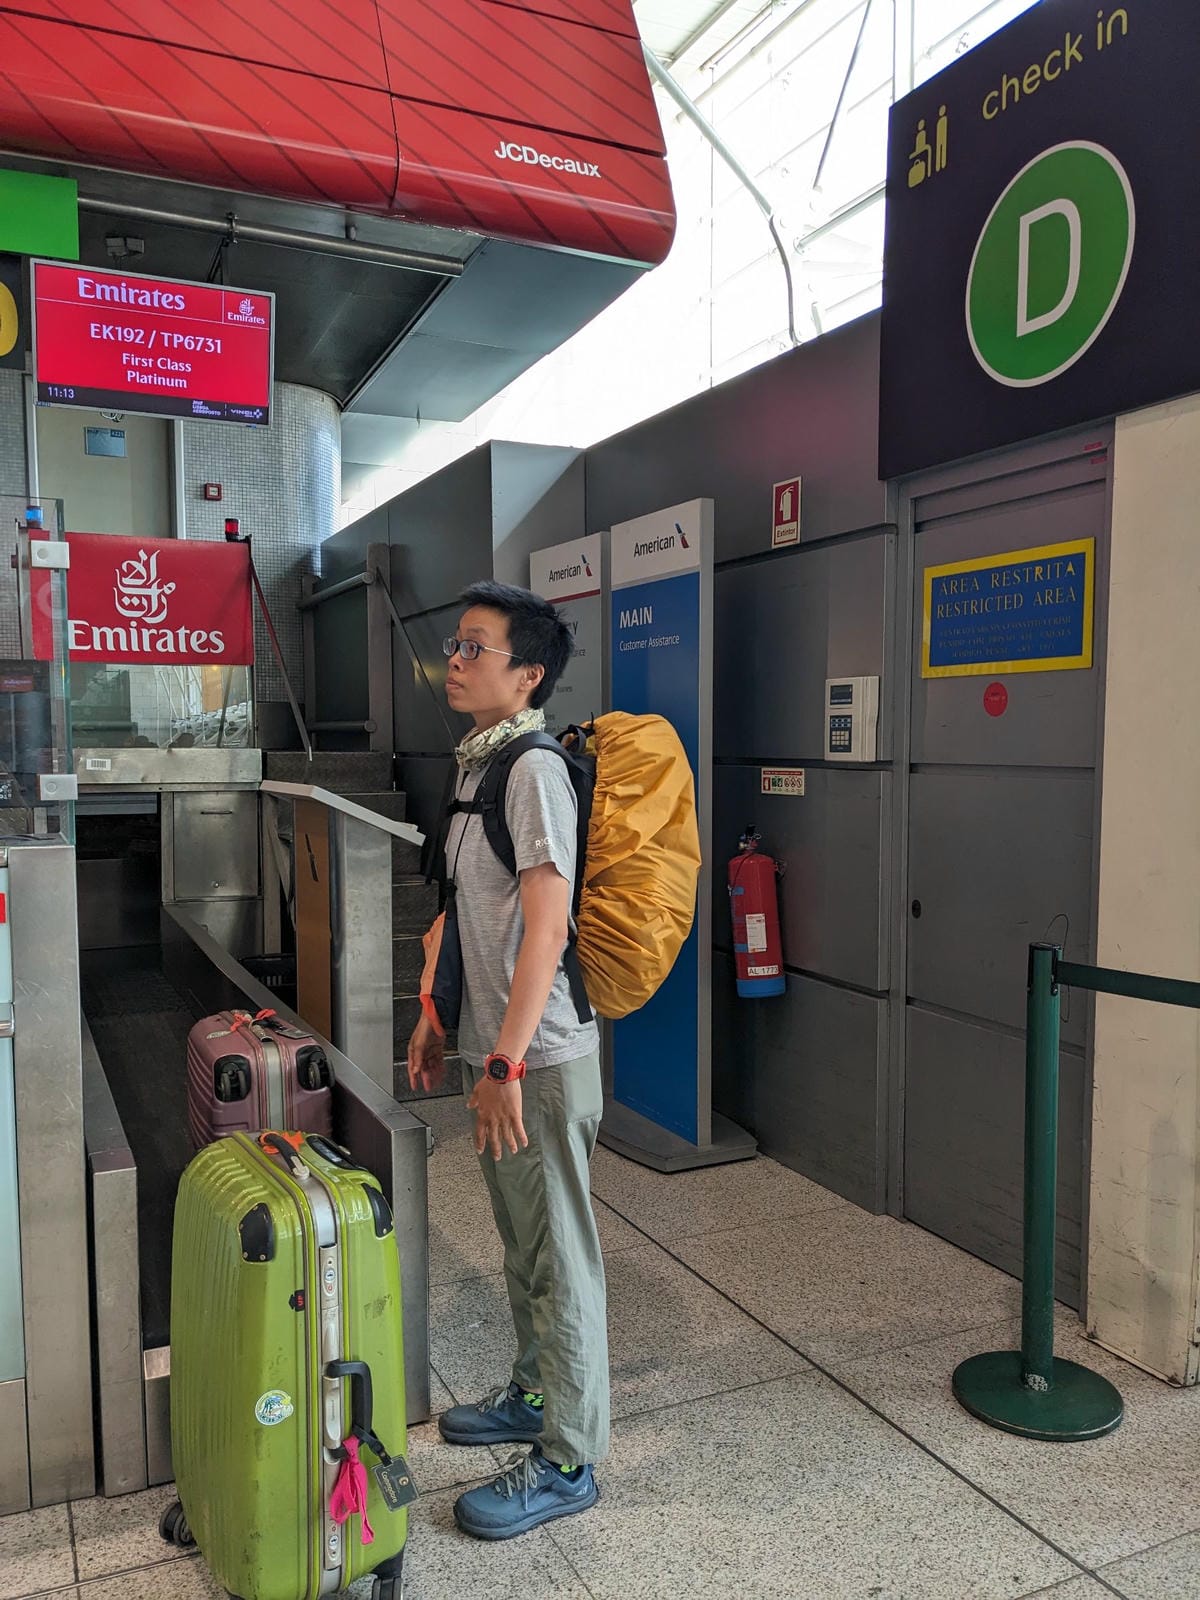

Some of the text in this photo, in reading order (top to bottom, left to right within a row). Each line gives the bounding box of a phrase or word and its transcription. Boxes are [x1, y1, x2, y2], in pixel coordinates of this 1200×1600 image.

[982, 8, 1127, 119] check in
[494, 141, 602, 178] JCDecaux
[1016, 198, 1081, 338] D
[77, 277, 186, 311] Emirates
[227, 312, 266, 325] Emirates
[90, 323, 222, 354] EK192 / TP6731
[122, 353, 192, 373] First Class
[127, 370, 188, 389] Platinum
[48, 387, 74, 399] 11:13
[777, 528, 795, 538] Extintor
[634, 535, 675, 557] American
[549, 564, 582, 583] American
[991, 561, 1076, 588] RESTRITA
[937, 586, 1076, 619] RESTRICTED AREA
[619, 606, 653, 629] MAIN
[68, 619, 225, 654] Emirates
[619, 633, 681, 652] Customer Assistance
